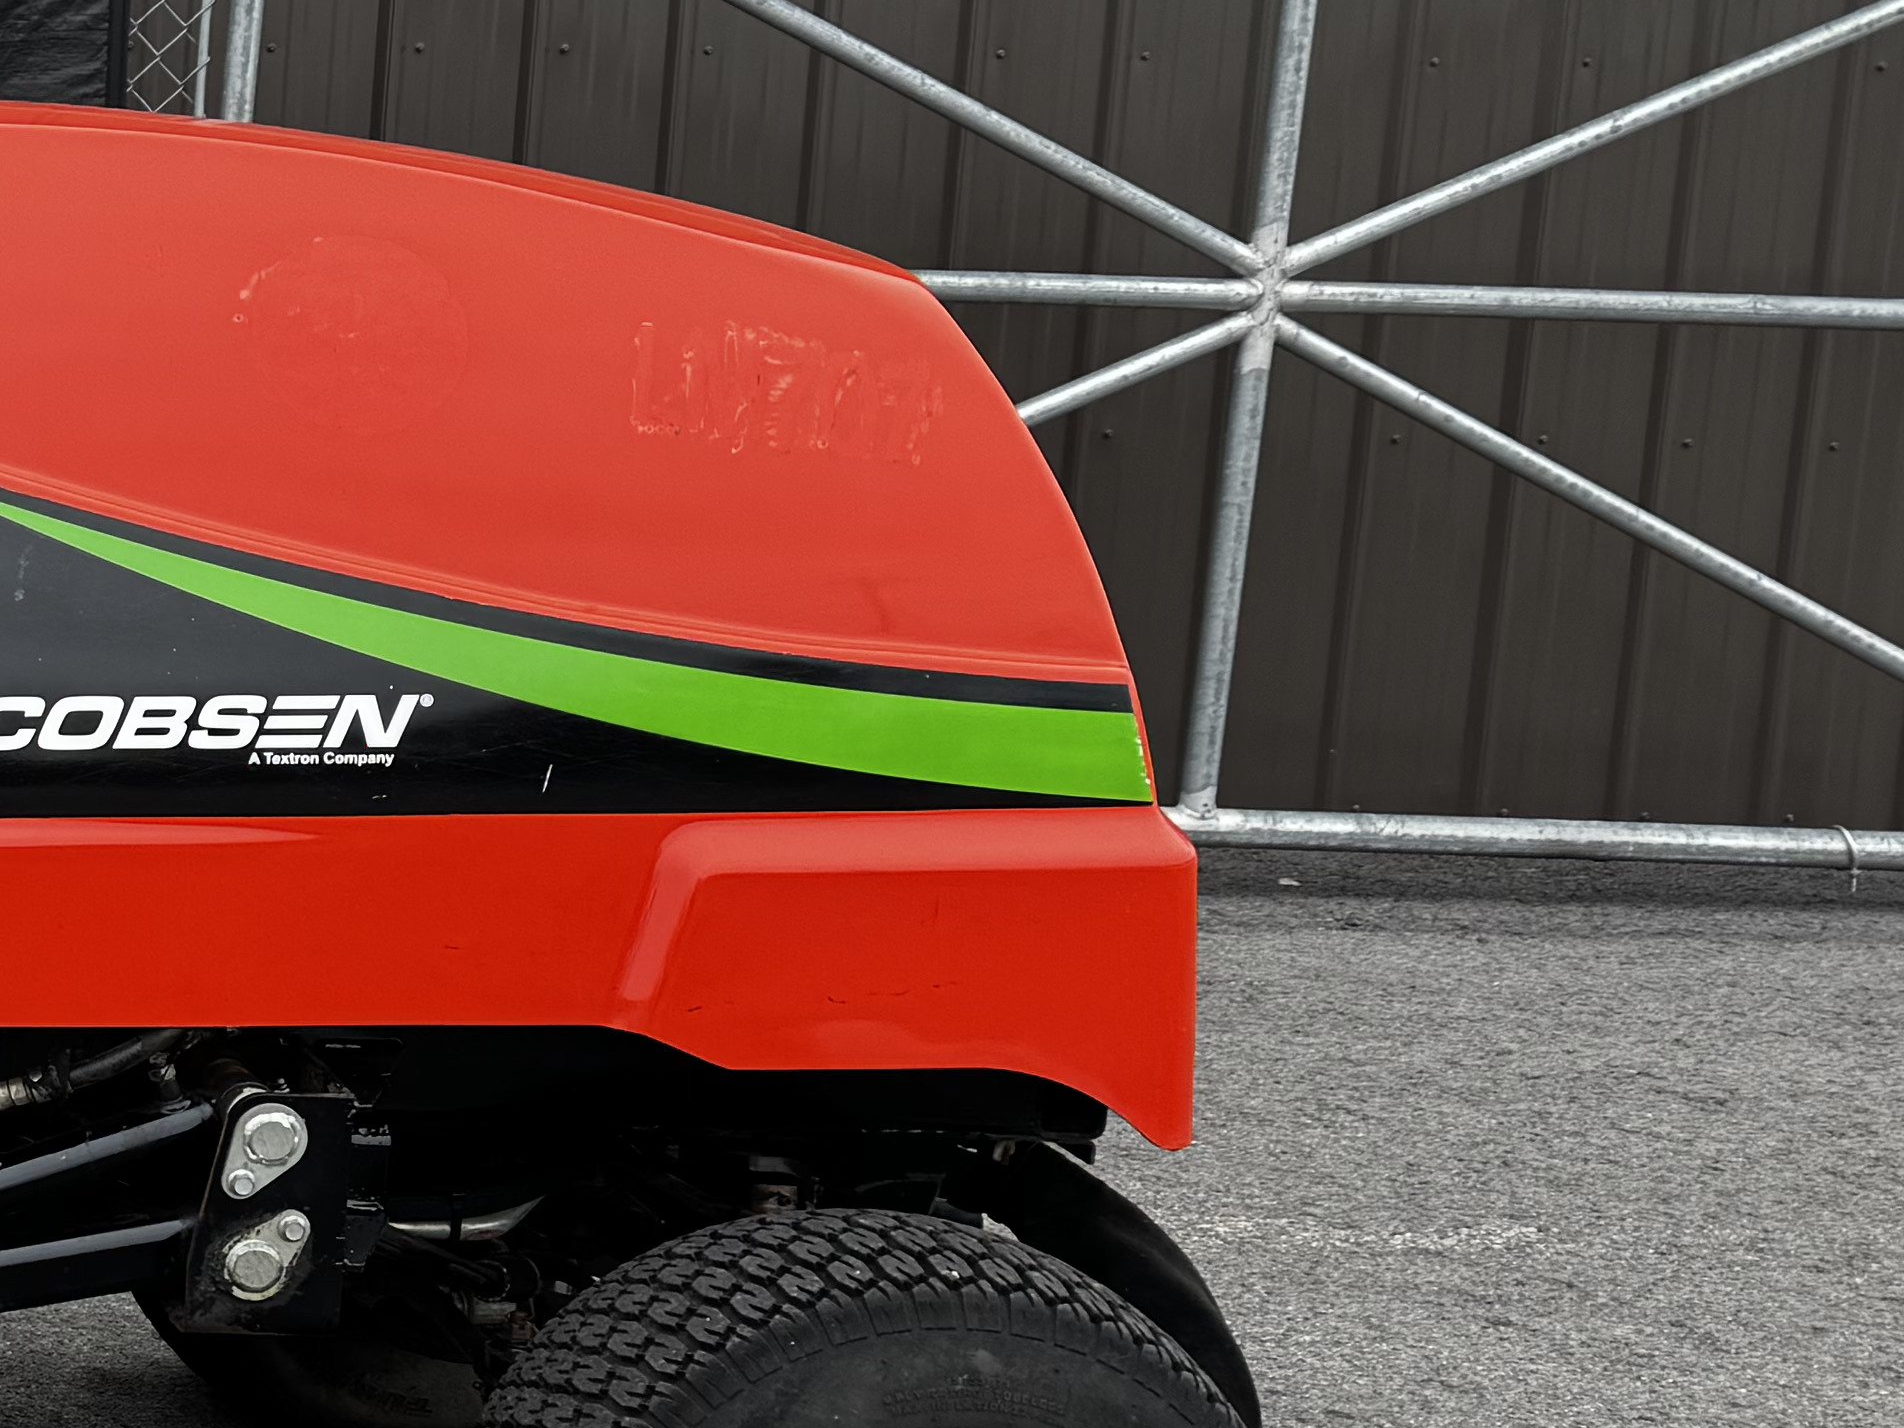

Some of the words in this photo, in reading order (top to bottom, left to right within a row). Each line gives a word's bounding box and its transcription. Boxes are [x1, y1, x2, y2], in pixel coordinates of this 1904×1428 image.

[248, 752, 260, 765] A
[263, 752, 320, 765] Textron
[323, 752, 395, 767] Company
